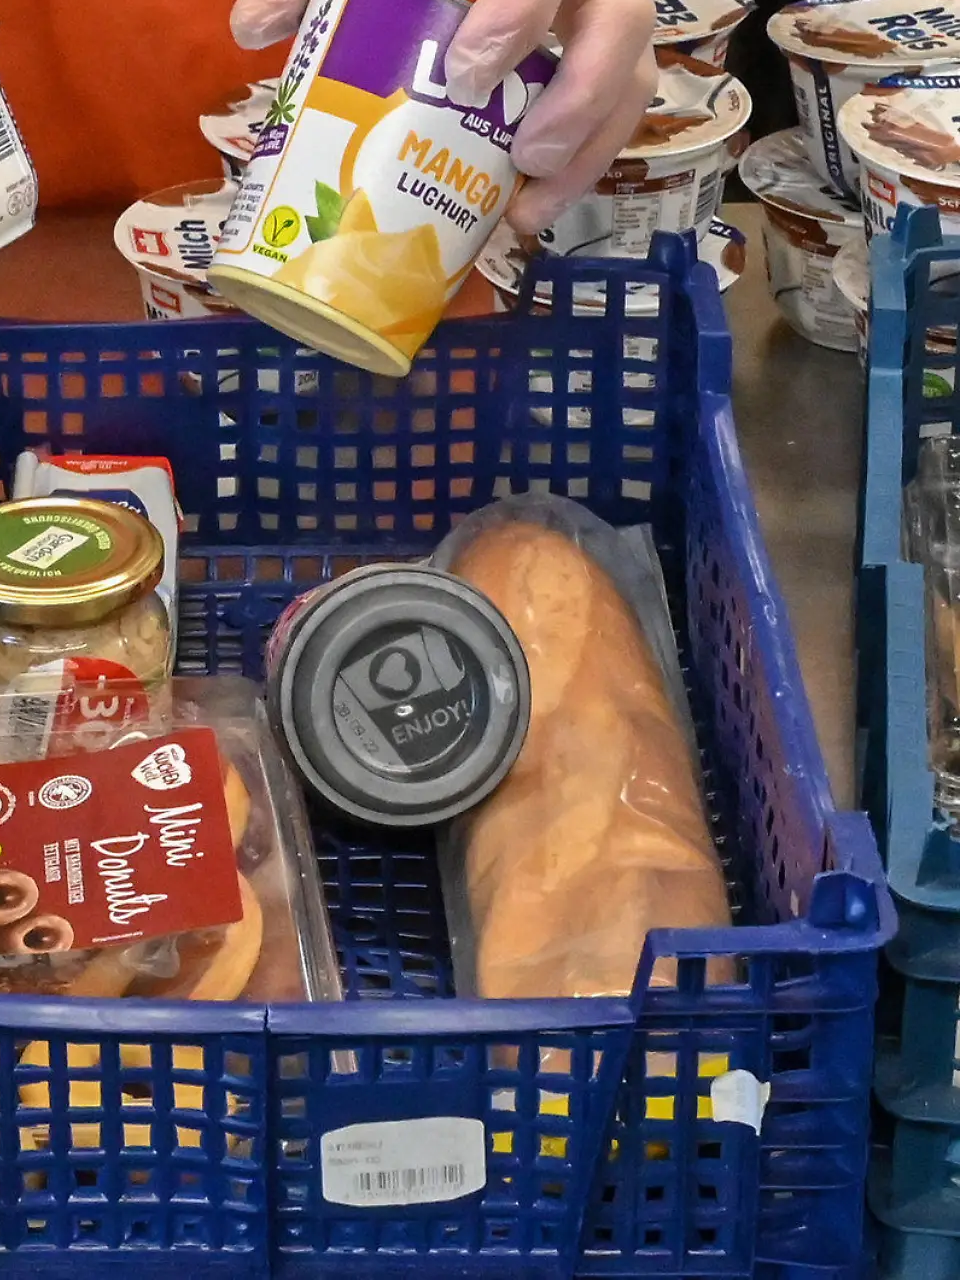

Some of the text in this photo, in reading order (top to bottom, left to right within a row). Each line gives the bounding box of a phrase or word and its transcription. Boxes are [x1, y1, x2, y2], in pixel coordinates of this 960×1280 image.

[868, 14, 947, 50] Reis
[464, 113, 491, 134] AUS
[818, 84, 840, 176] ORIGINAL
[397, 129, 500, 216] MANGO
[396, 172, 478, 234] LUGHURT
[174, 219, 214, 270] Milch
[253, 245, 288, 264] VEGAN
[392, 699, 472, 745] ENJOY!
[143, 803, 204, 867] Mini
[90, 831, 168, 925] Donuts
